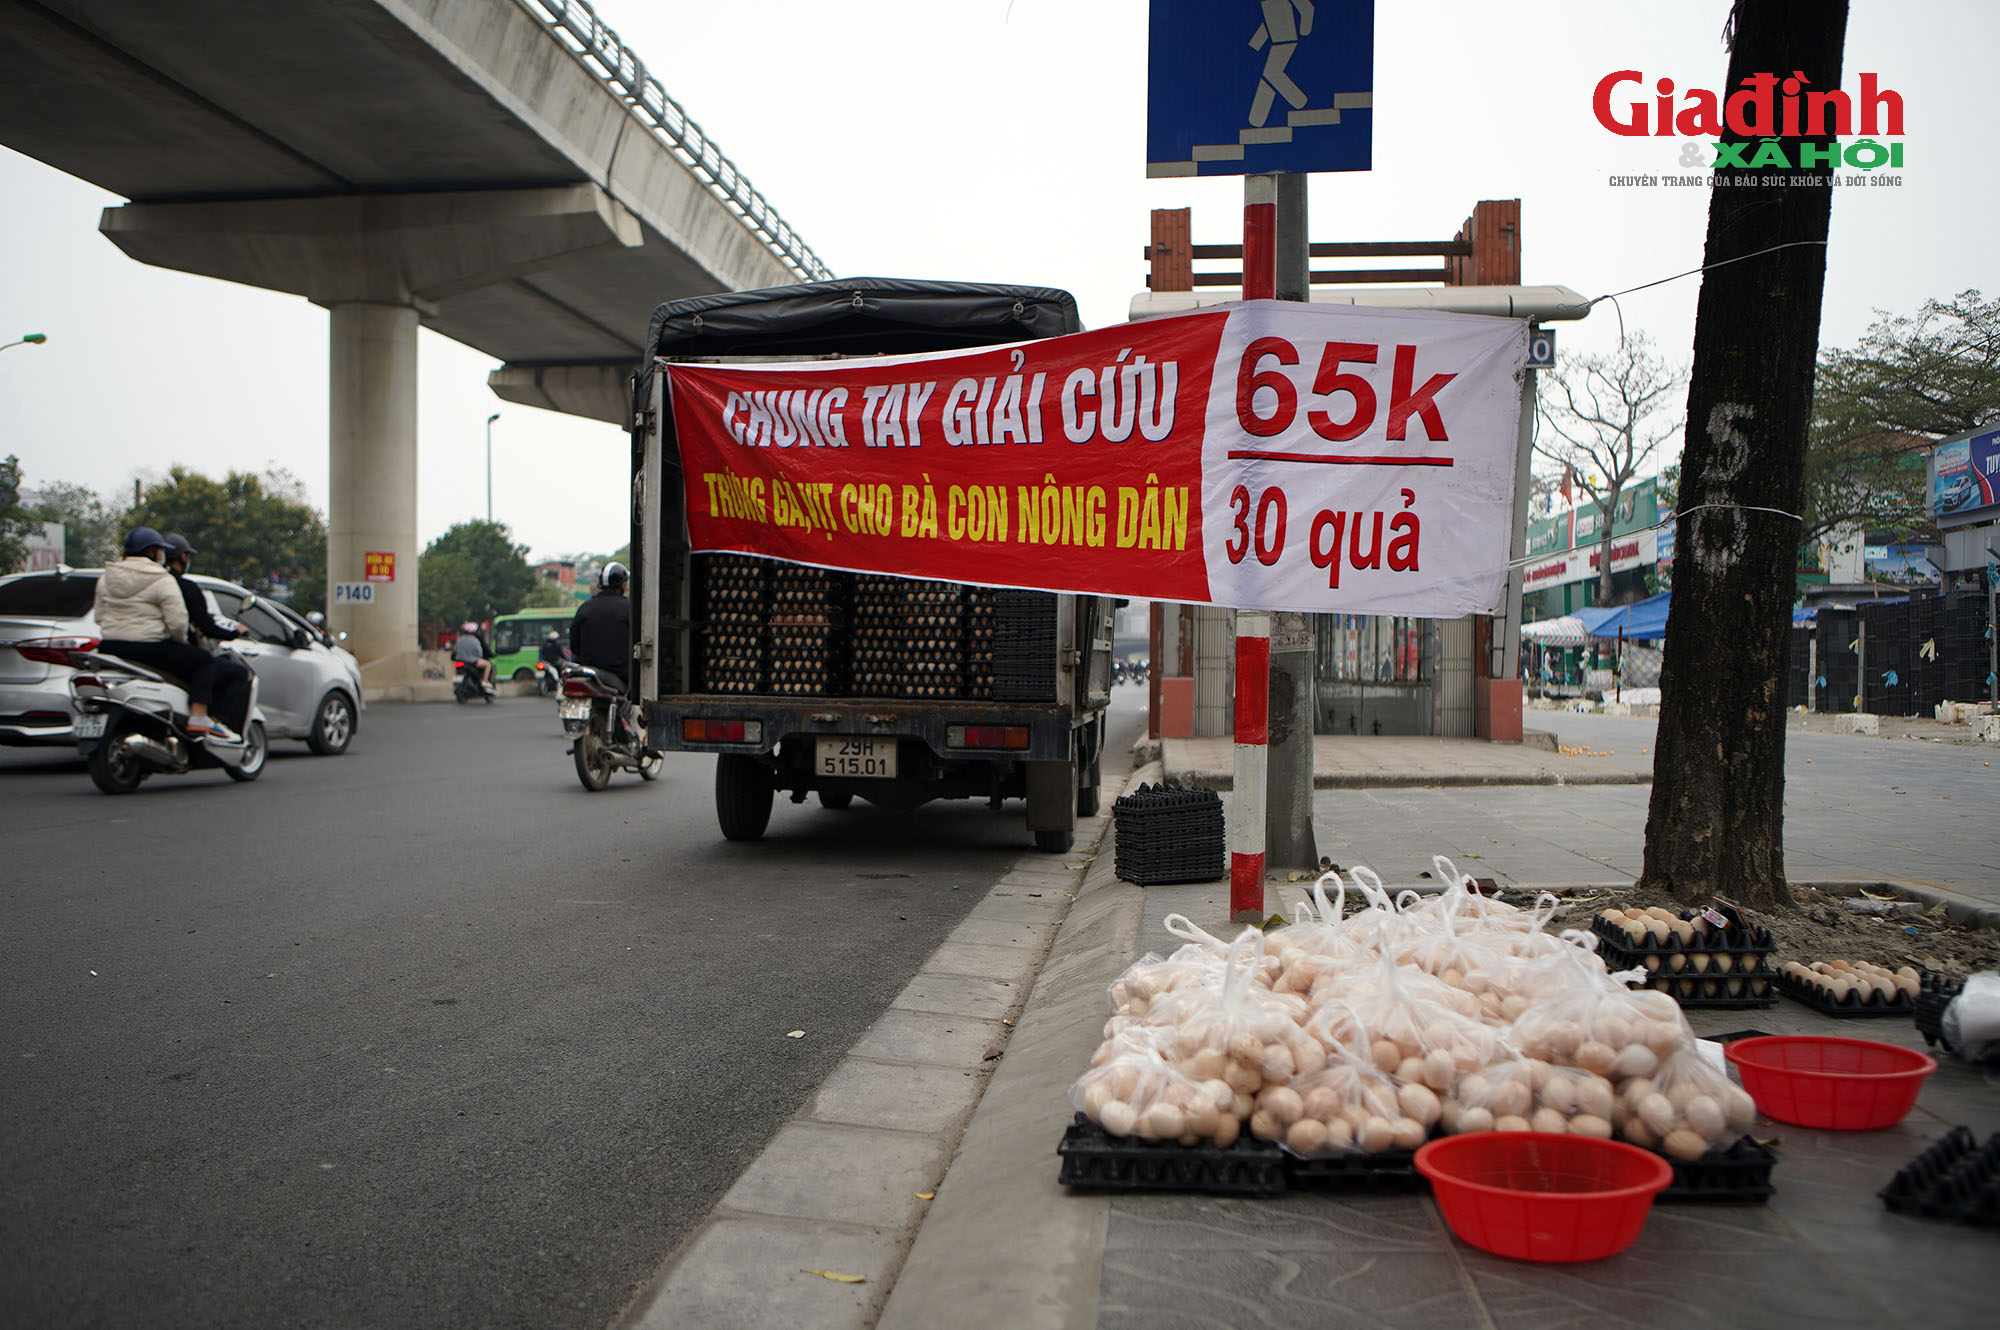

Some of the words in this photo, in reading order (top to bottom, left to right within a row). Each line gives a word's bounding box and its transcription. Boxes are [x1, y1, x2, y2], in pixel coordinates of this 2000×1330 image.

[722, 387, 850, 448] CHUNG
[862, 381, 938, 448] TAY
[942, 349, 1048, 447] GIẢI
[1060, 348, 1180, 443] CỨU
[1236, 336, 1459, 442] 65k
[703, 466, 769, 524] TRỨNG
[841, 483, 893, 537] CHO
[901, 473, 938, 539] BÀ
[948, 484, 1009, 542] CON
[1017, 473, 1106, 548] NÔNG
[1116, 472, 1189, 551] DÂN
[1225, 484, 1288, 567] 30
[1309, 487, 1420, 590] quả
[336, 585, 371, 600] P140
[824, 757, 887, 775] 515.01
[839, 740, 874, 756] 29H
